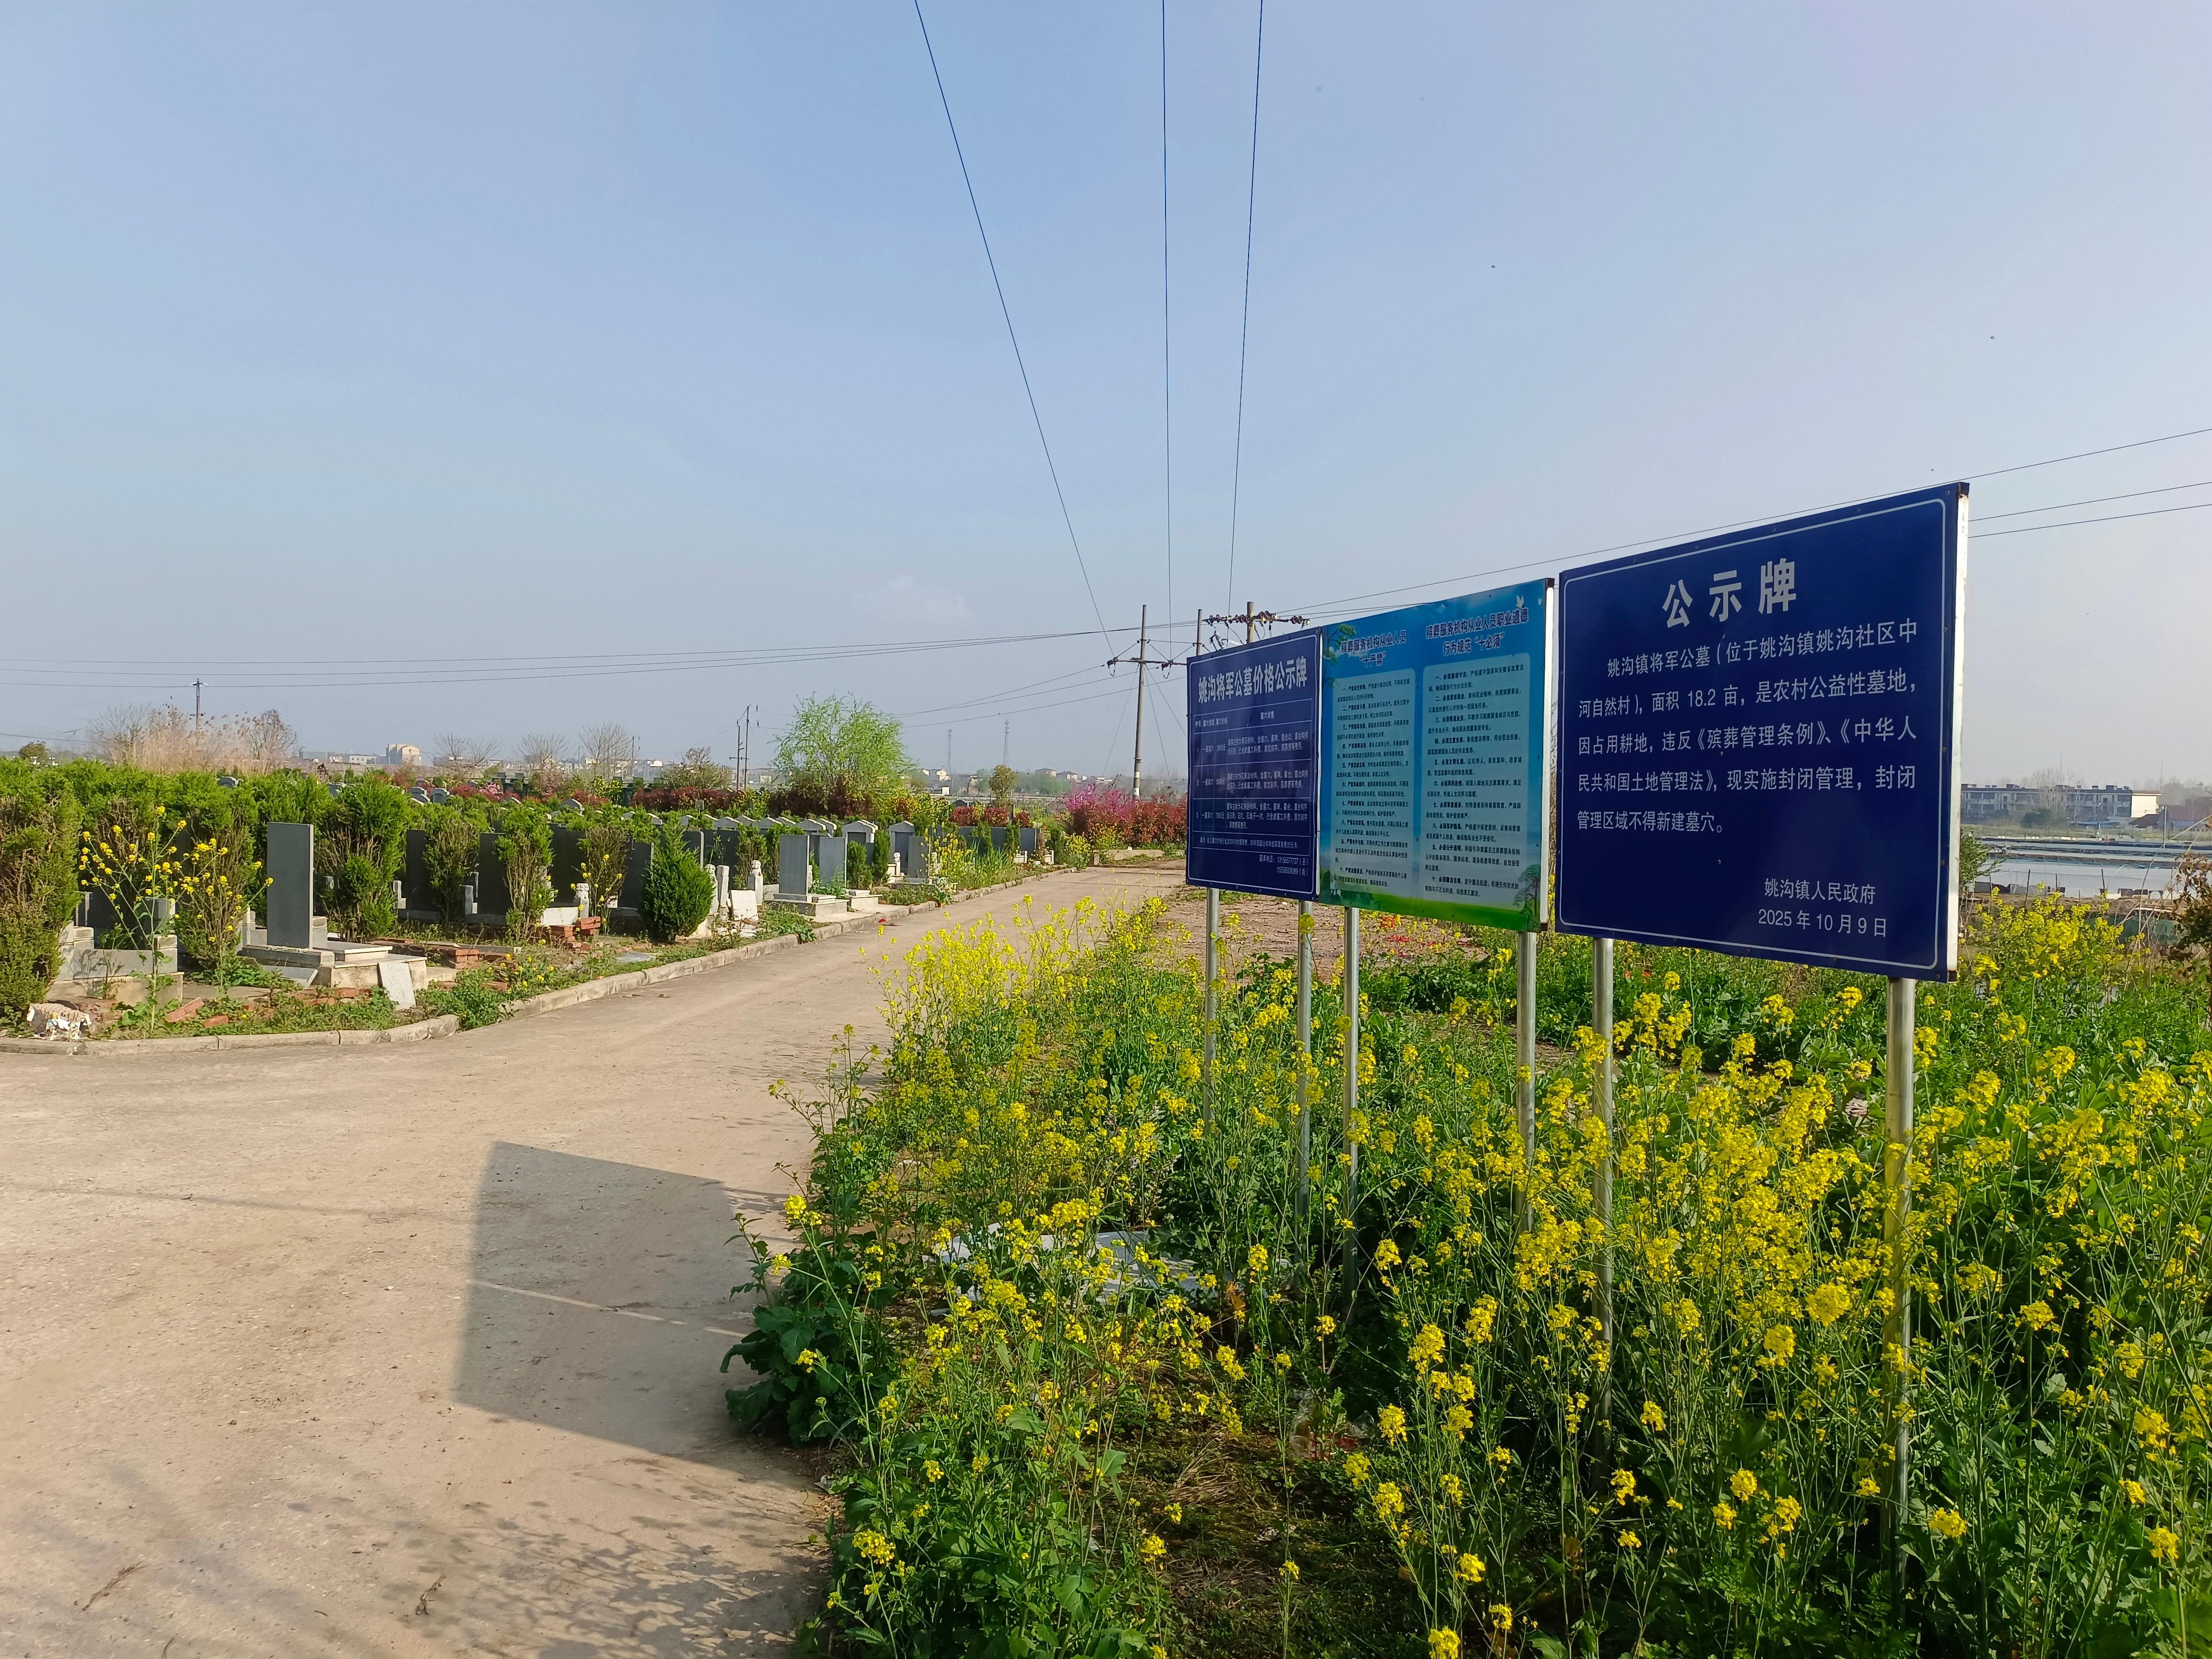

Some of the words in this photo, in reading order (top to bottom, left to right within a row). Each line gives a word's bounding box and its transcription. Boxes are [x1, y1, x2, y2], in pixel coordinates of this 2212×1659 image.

[1662, 558, 1796, 628] 公示牌
[1426, 607, 1529, 640] 殡葬服务机构从业人员职业道德
[1340, 630, 1407, 653] 殡葬服务机构从业人员
[1608, 618, 1916, 677] 姚沟镇将军公墓（位于姚沟镇姚沟社区中
[1198, 656, 1307, 703] 姚沟将军公墓价格公示牌
[1579, 716, 1916, 755] 因占用耕地，违反《殡葬管理条例》、《中华人
[1579, 765, 1915, 792] 民共和国土地管理法》，现实施封闭管理，封闭
[1578, 810, 1722, 832] 管理区域不得新建墓穴。
[1765, 878, 1875, 904] 姚沟镇人民政府
